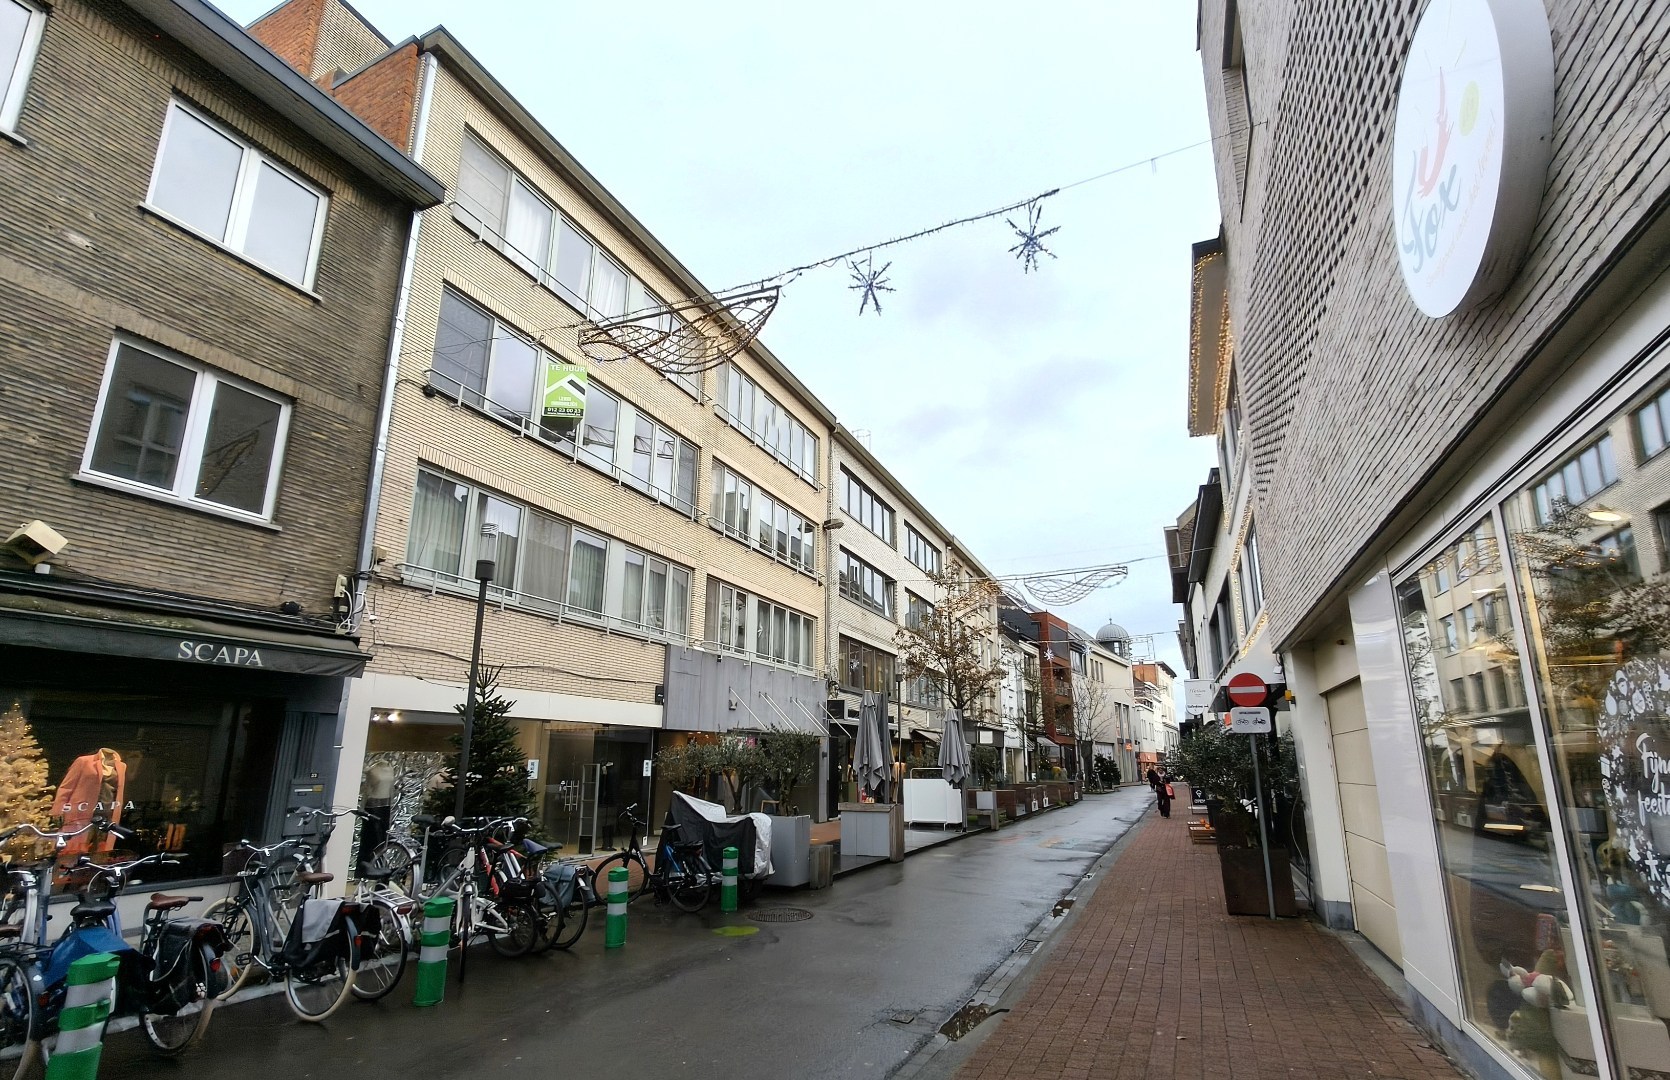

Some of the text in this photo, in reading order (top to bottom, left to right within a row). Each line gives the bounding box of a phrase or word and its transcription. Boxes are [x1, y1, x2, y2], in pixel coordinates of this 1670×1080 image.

[1402, 150, 1462, 274] Fox
[178, 641, 264, 667] SCAPA
[62, 800, 135, 812] SCAPA
